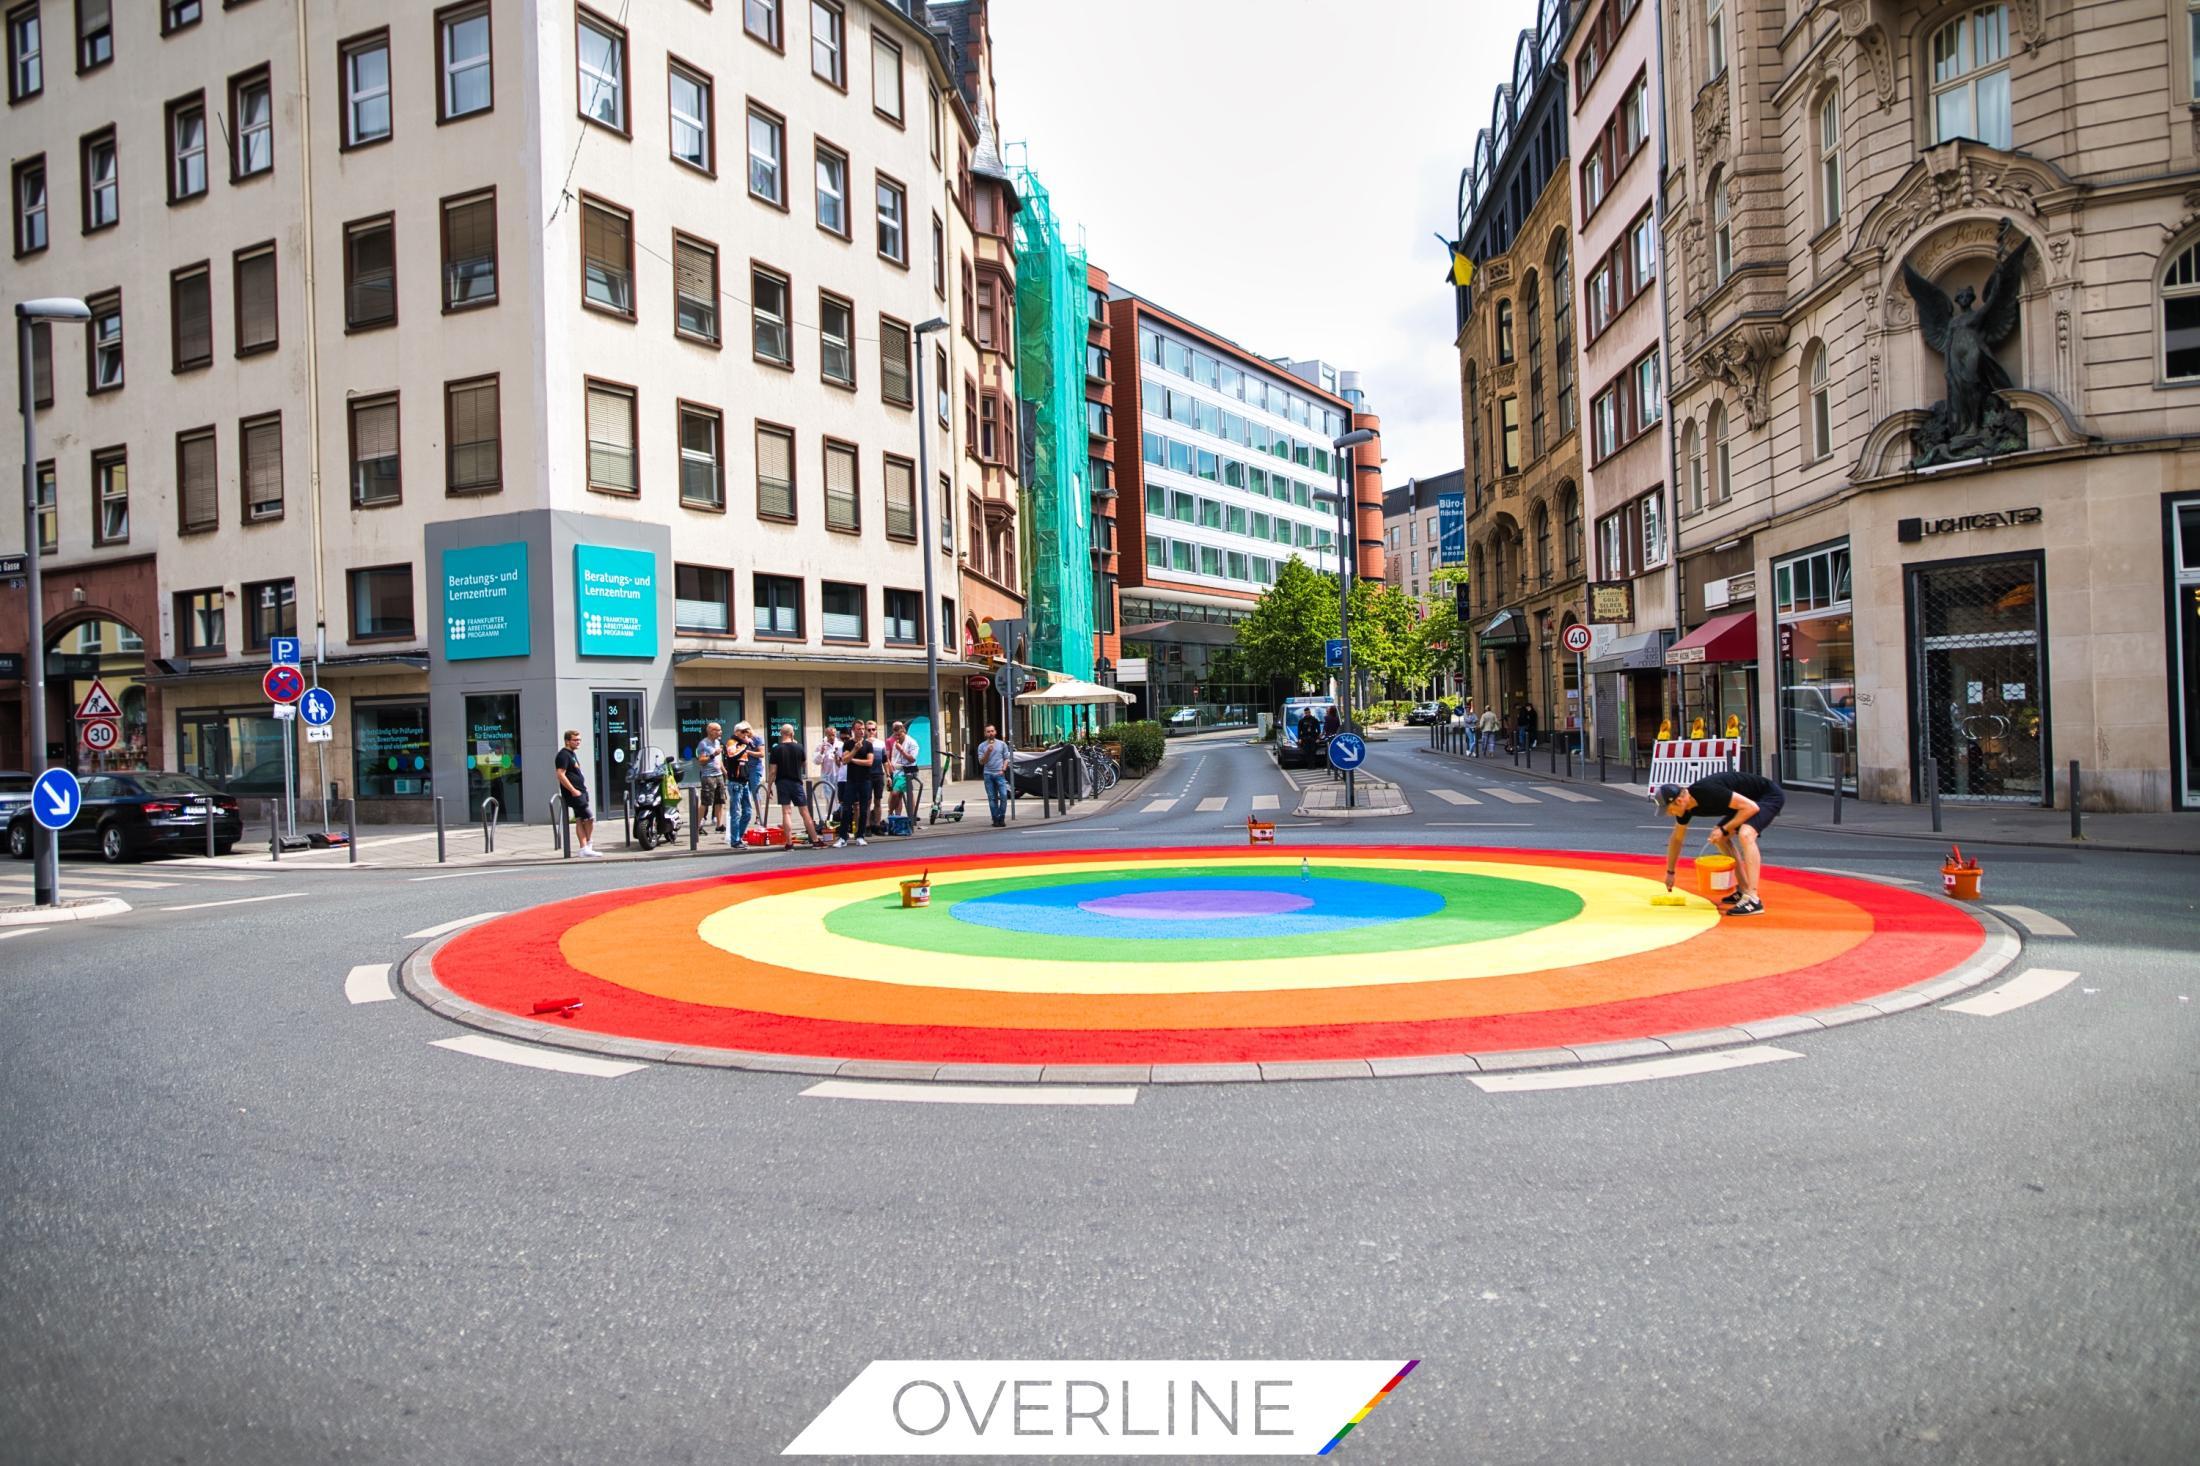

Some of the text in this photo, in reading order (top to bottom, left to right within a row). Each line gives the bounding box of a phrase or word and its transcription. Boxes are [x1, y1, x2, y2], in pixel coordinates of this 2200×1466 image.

[1440, 500, 1463, 508] Büro-
[1925, 507, 2042, 534] LICHTCENTER
[3, 562, 20, 571] Gasse
[449, 569, 518, 586] Beratungs- und
[584, 569, 651, 586] Beratungs- und
[449, 587, 507, 600] Lernzentrum
[585, 583, 641, 599] Lernzentrum
[467, 616, 505, 625] FRANKFURTER
[602, 616, 638, 624] FRANKFURTER
[467, 623, 508, 631] ARBEITSMARKT
[467, 630, 500, 638] PROGRAMM
[1570, 631, 1586, 645] 40
[278, 641, 293, 660] P
[1335, 650, 1342, 658] P
[608, 705, 618, 715] 36
[91, 727, 110, 742] 30
